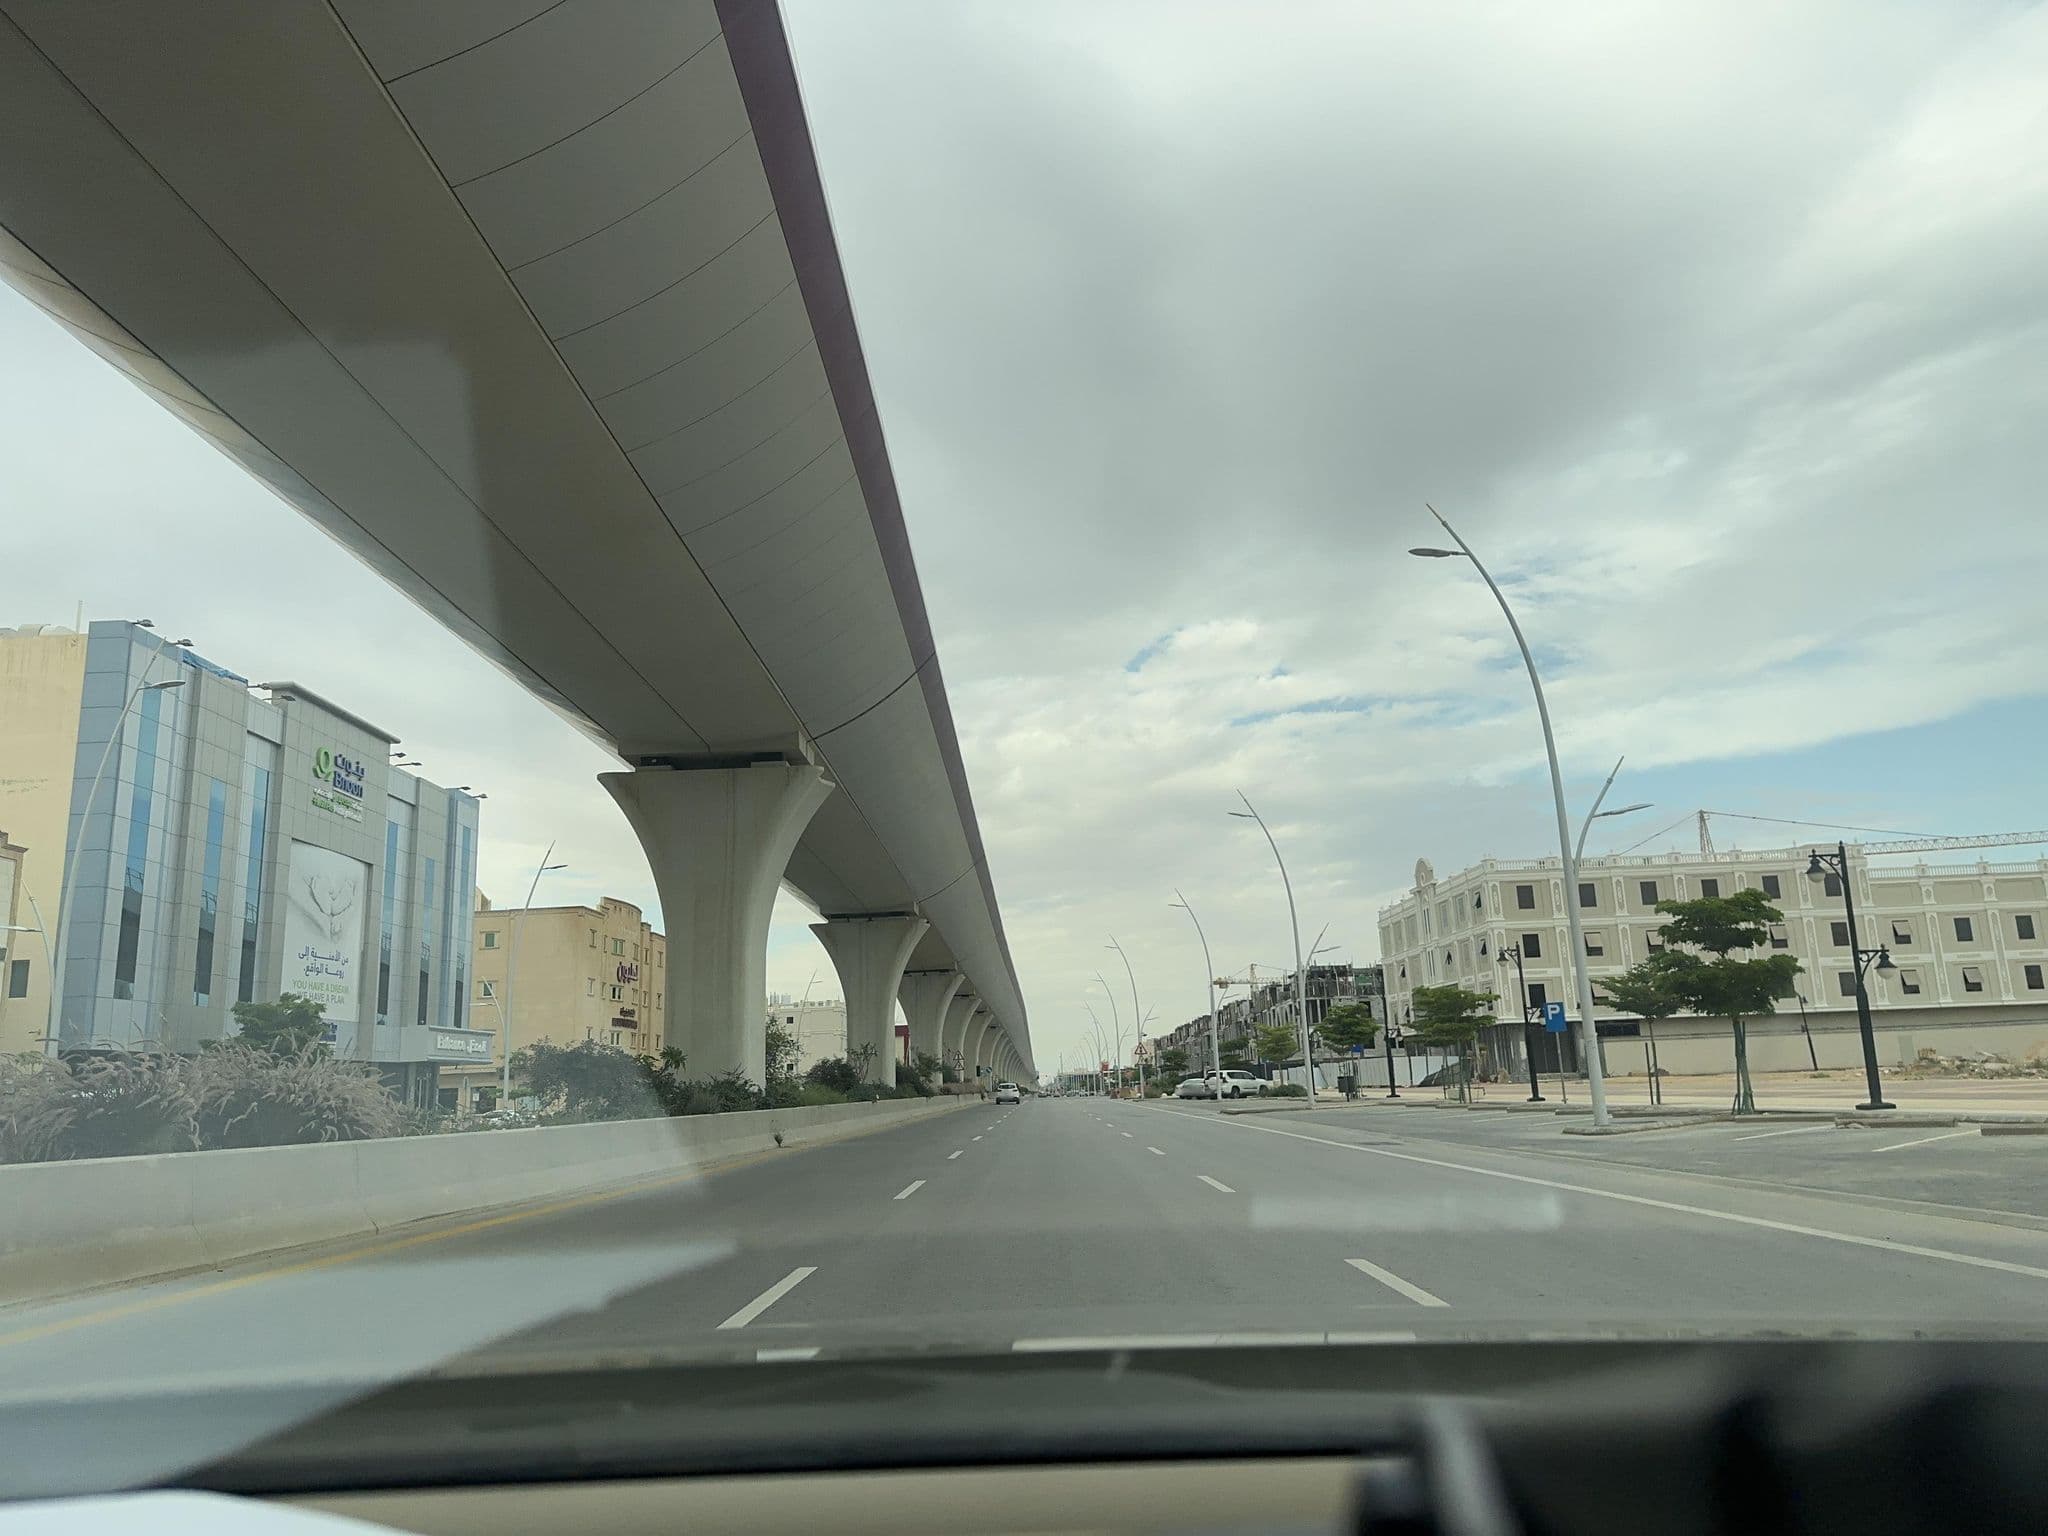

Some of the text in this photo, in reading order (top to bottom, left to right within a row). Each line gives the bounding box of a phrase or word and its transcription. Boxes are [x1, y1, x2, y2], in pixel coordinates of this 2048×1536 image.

[293, 979, 308, 989] YOU
[308, 980, 324, 992] HAVE
[309, 991, 325, 1002] HAVE
[1547, 1004, 1560, 1020] P
